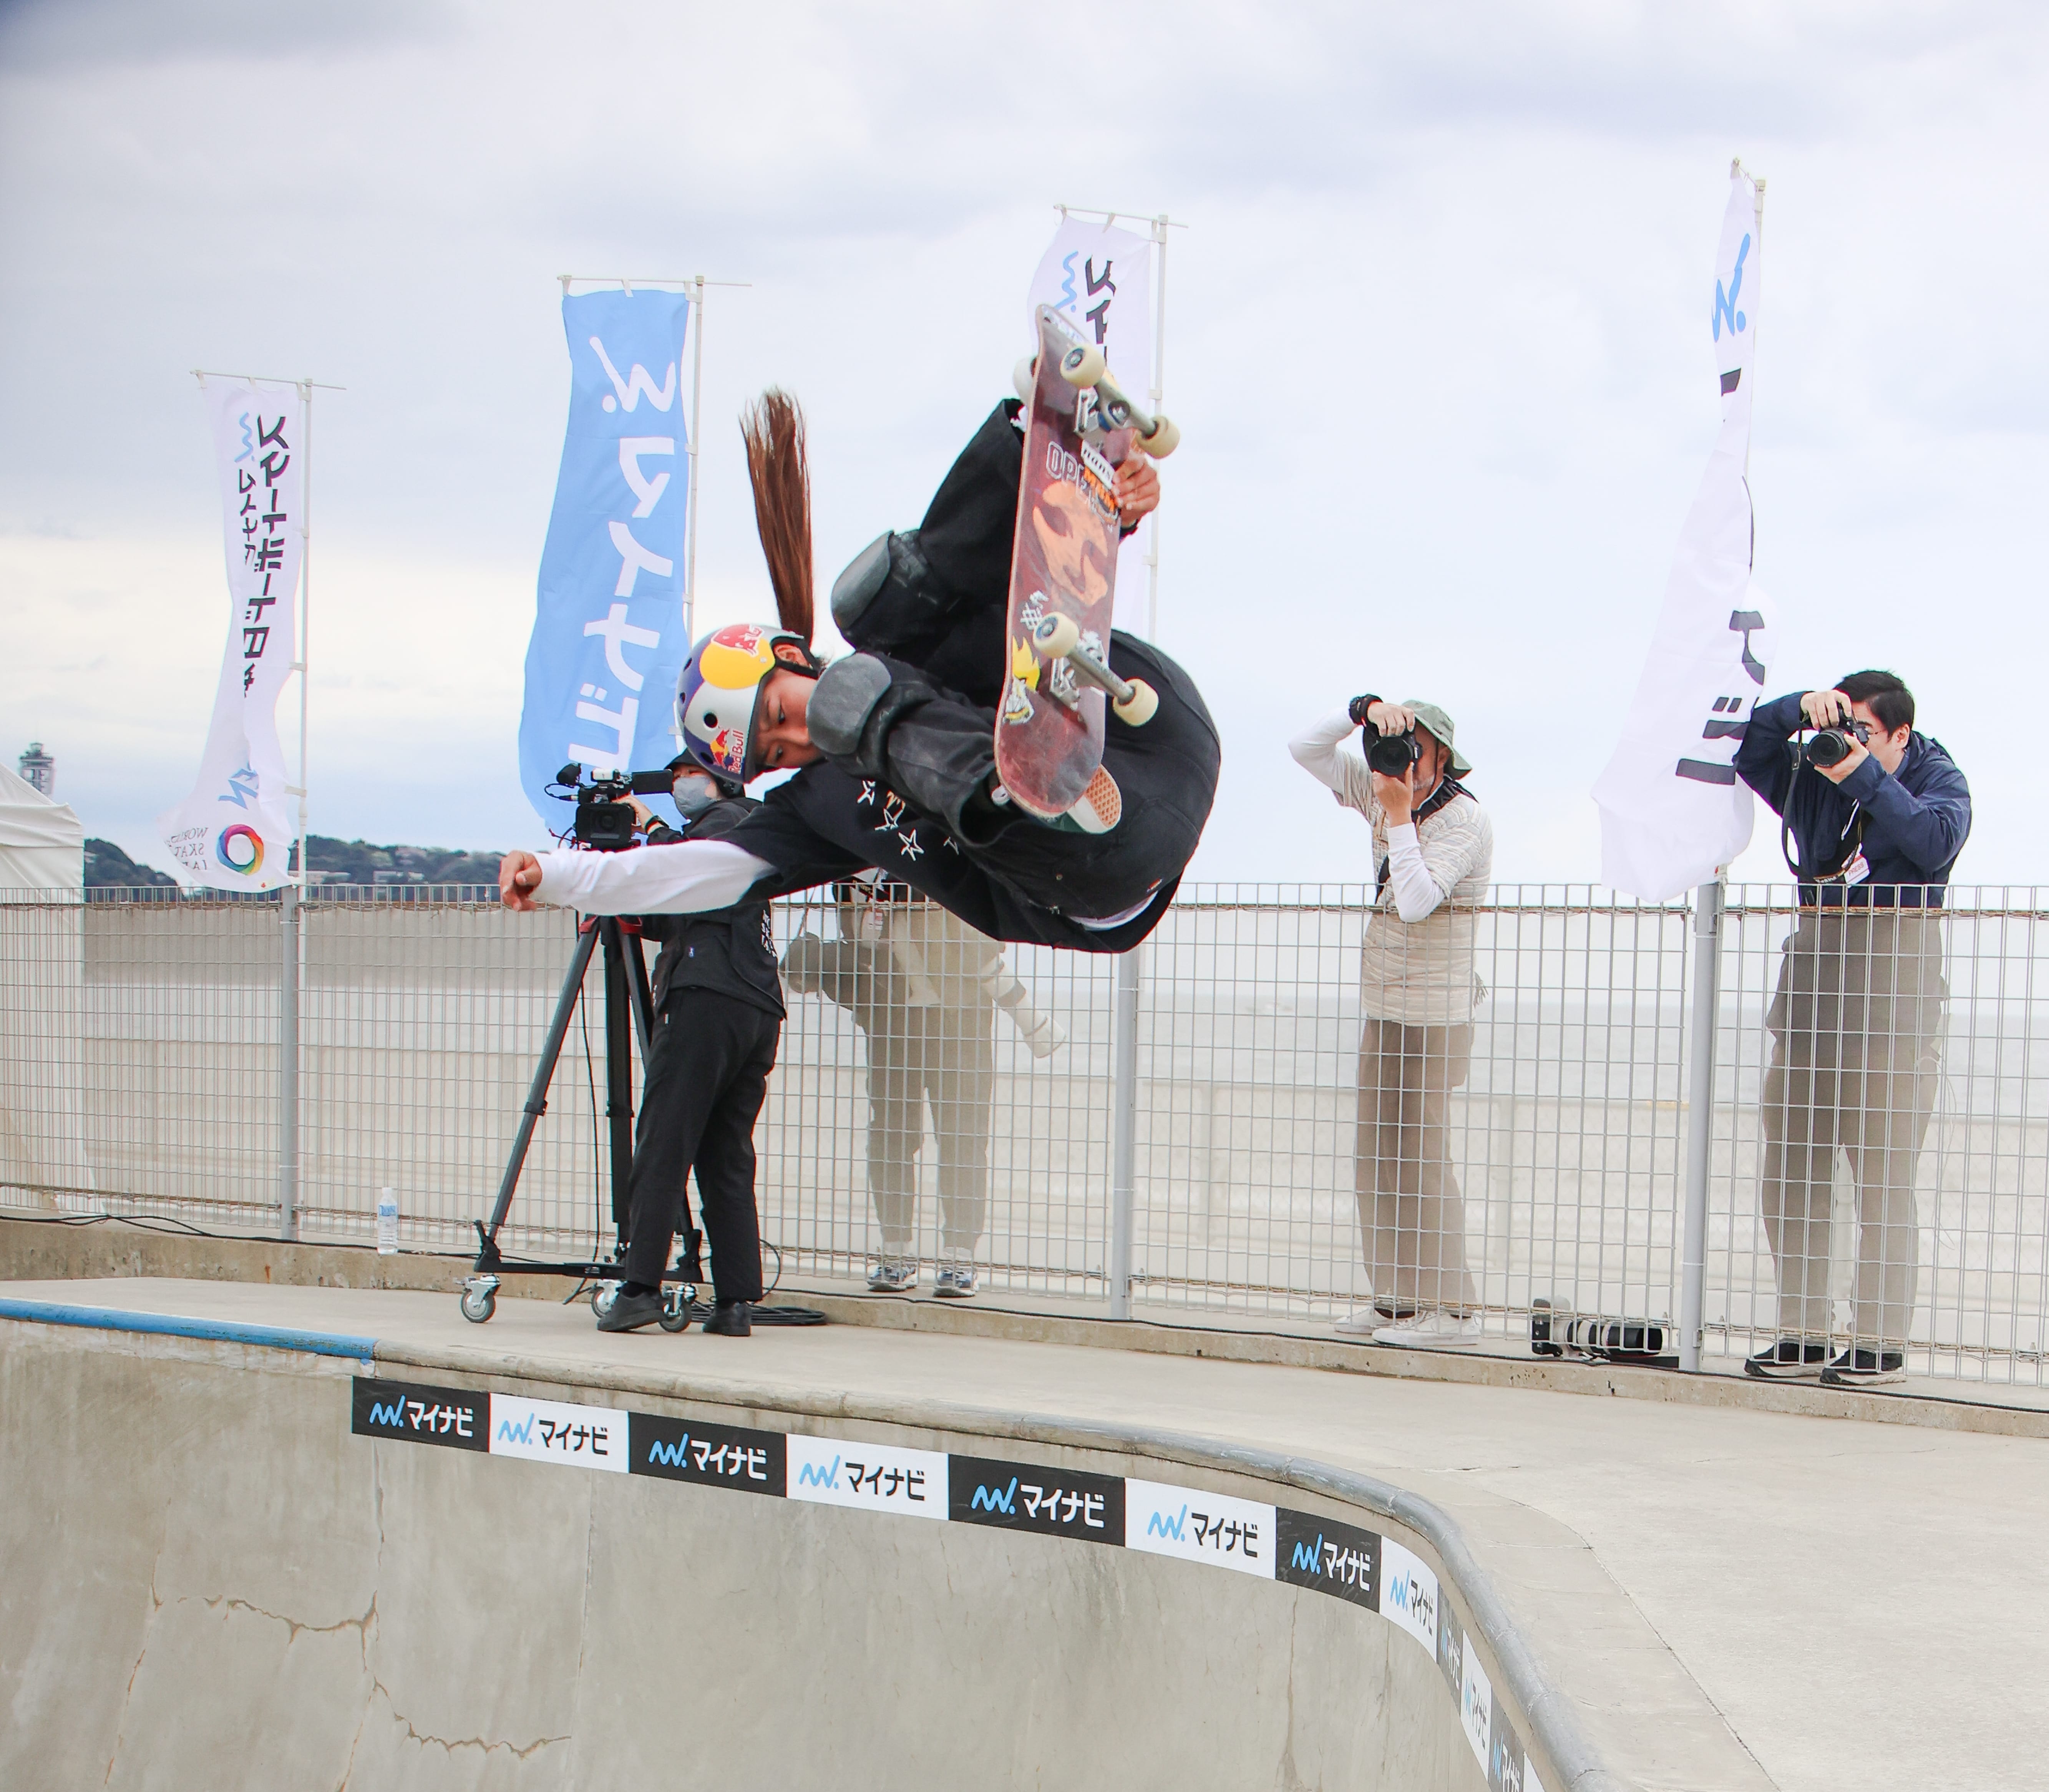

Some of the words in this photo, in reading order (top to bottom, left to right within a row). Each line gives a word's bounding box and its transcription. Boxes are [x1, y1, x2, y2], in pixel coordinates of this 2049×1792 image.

[732, 729, 744, 754] Bull
[727, 753, 742, 774] Red
[1848, 862, 1864, 876] PRESS
[406, 1400, 473, 1438] マイナビ
[539, 1419, 608, 1456] マイナビ
[690, 1439, 767, 1481] マイナビ
[844, 1462, 925, 1501] マイナビ
[1020, 1484, 1105, 1529] マイナビ
[1191, 1512, 1258, 1558] マイナビ
[1324, 1541, 1371, 1591] マイナビ
[1410, 1580, 1434, 1636] マイナビ
[1447, 1627, 1460, 1690] マイナビ
[1472, 1682, 1487, 1749] マイナビ
